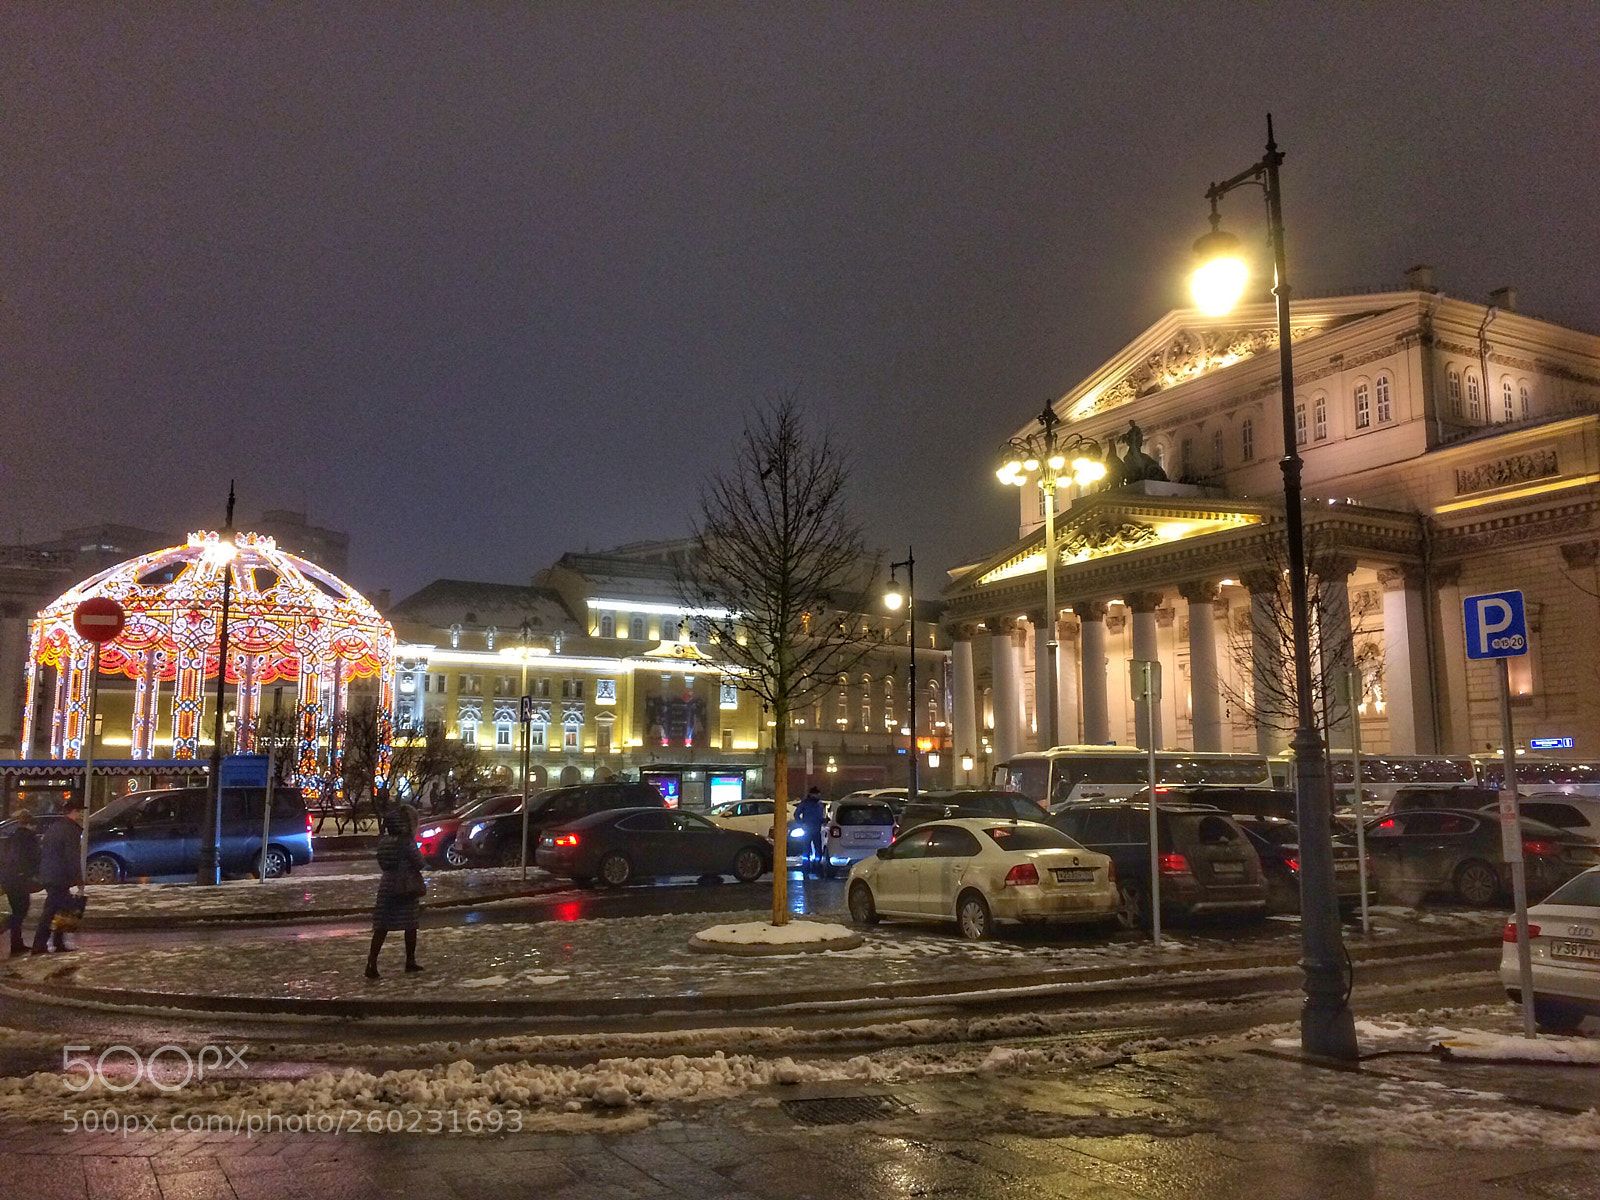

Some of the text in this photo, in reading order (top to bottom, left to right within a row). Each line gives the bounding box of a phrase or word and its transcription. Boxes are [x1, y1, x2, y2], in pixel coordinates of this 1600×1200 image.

[1477, 598, 1513, 653] P
[1501, 639, 1510, 647] 15
[1511, 637, 1523, 647] 20
